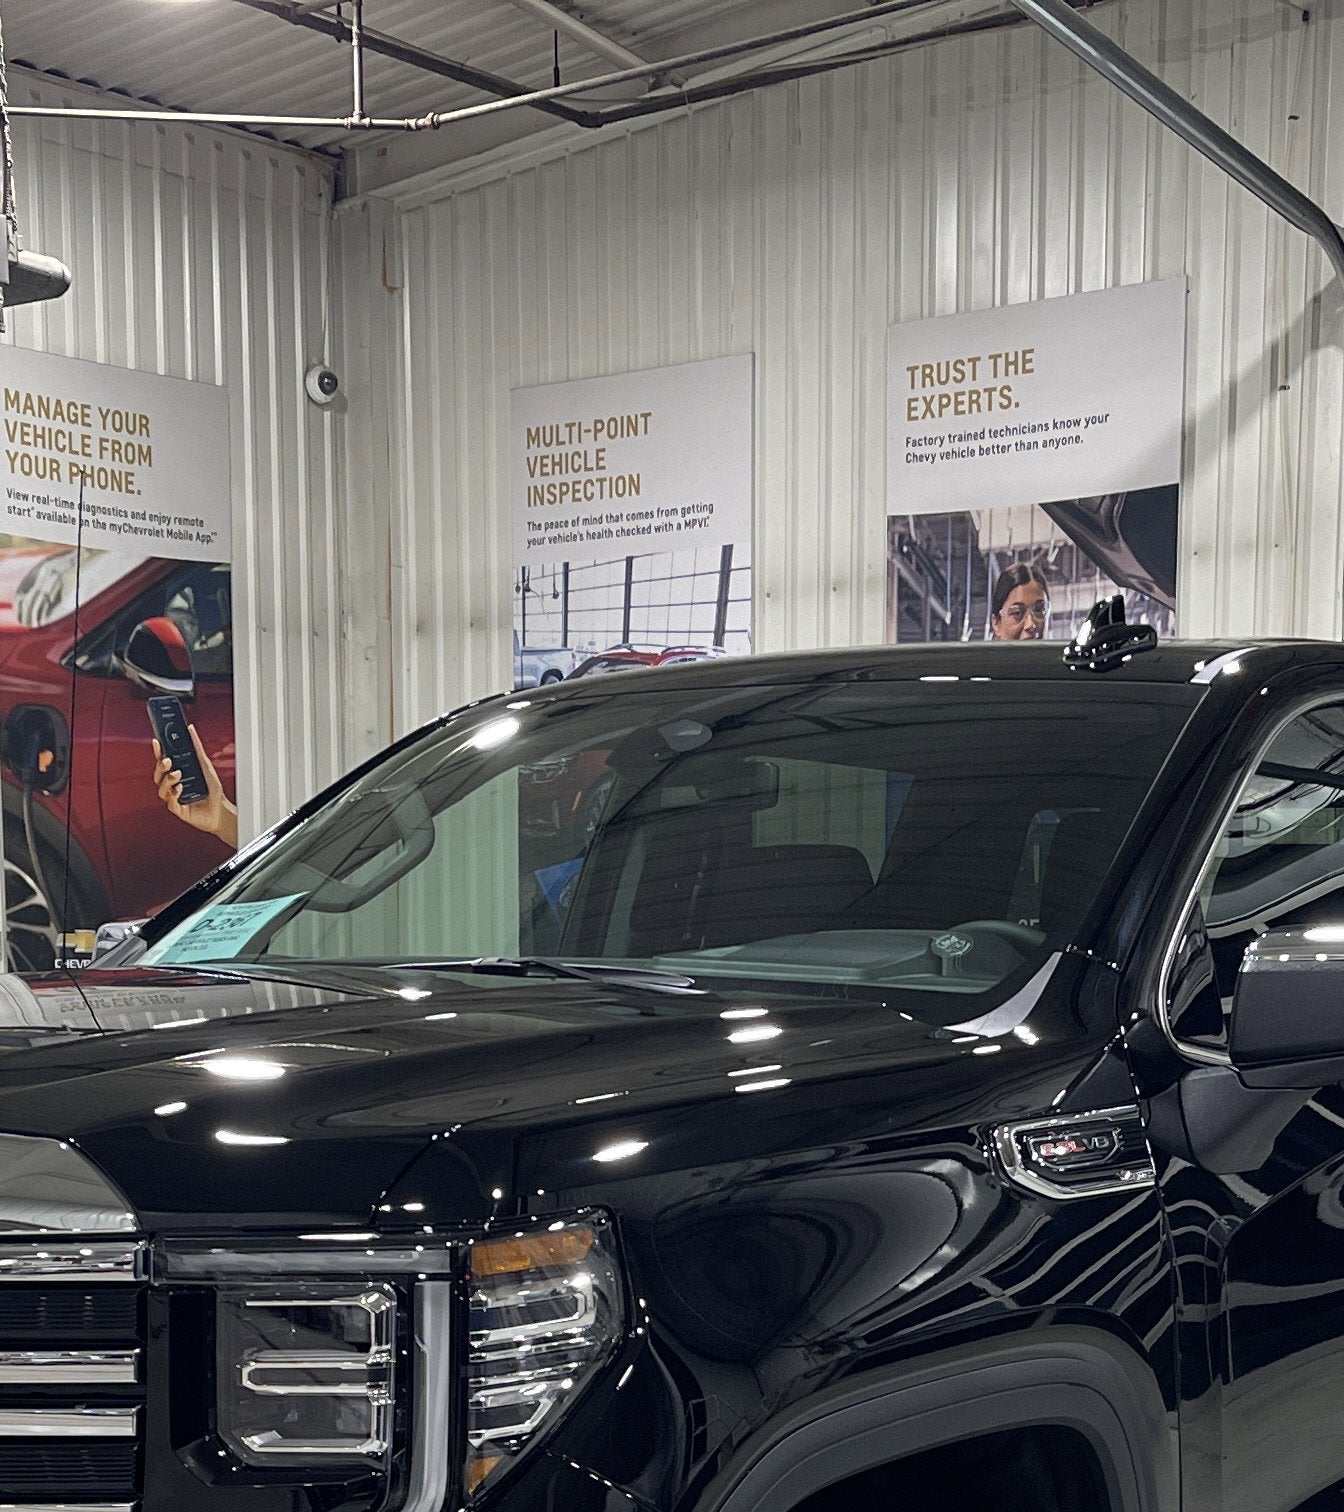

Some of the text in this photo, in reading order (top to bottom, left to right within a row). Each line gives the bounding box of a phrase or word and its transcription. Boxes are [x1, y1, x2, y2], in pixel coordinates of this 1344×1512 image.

[906, 348, 1035, 390] TRUST THE
[3, 387, 150, 438] MANAGE YOUR
[906, 384, 1020, 422] EXPERTS.
[4, 418, 153, 468] VEHICLE FROM
[526, 412, 652, 450] MULTI-POINT
[905, 434, 1084, 465] Chevy vehicle better than anyone.
[906, 413, 1110, 449] Factory trained technicians know your
[5, 450, 142, 496] YOUR PHONE.
[526, 448, 606, 478] VEHICLE
[6, 487, 29, 502] View
[31, 494, 75, 510] real-time
[130, 510, 147, 521] and
[148, 512, 171, 526] enjoy
[173, 516, 204, 527] remote
[527, 473, 641, 508] INSPECTION
[36, 511, 76, 525] available
[92, 518, 107, 530] the
[109, 522, 164, 539] myChevrolet
[166, 527, 193, 541] Mobile
[526, 502, 714, 533] The peace of mind that comes from getting
[527, 537, 546, 549] your
[547, 530, 584, 545] vehicle's
[586, 528, 613, 541] health
[615, 524, 652, 538] checked
[654, 521, 674, 534] with
[676, 522, 682, 531] a
